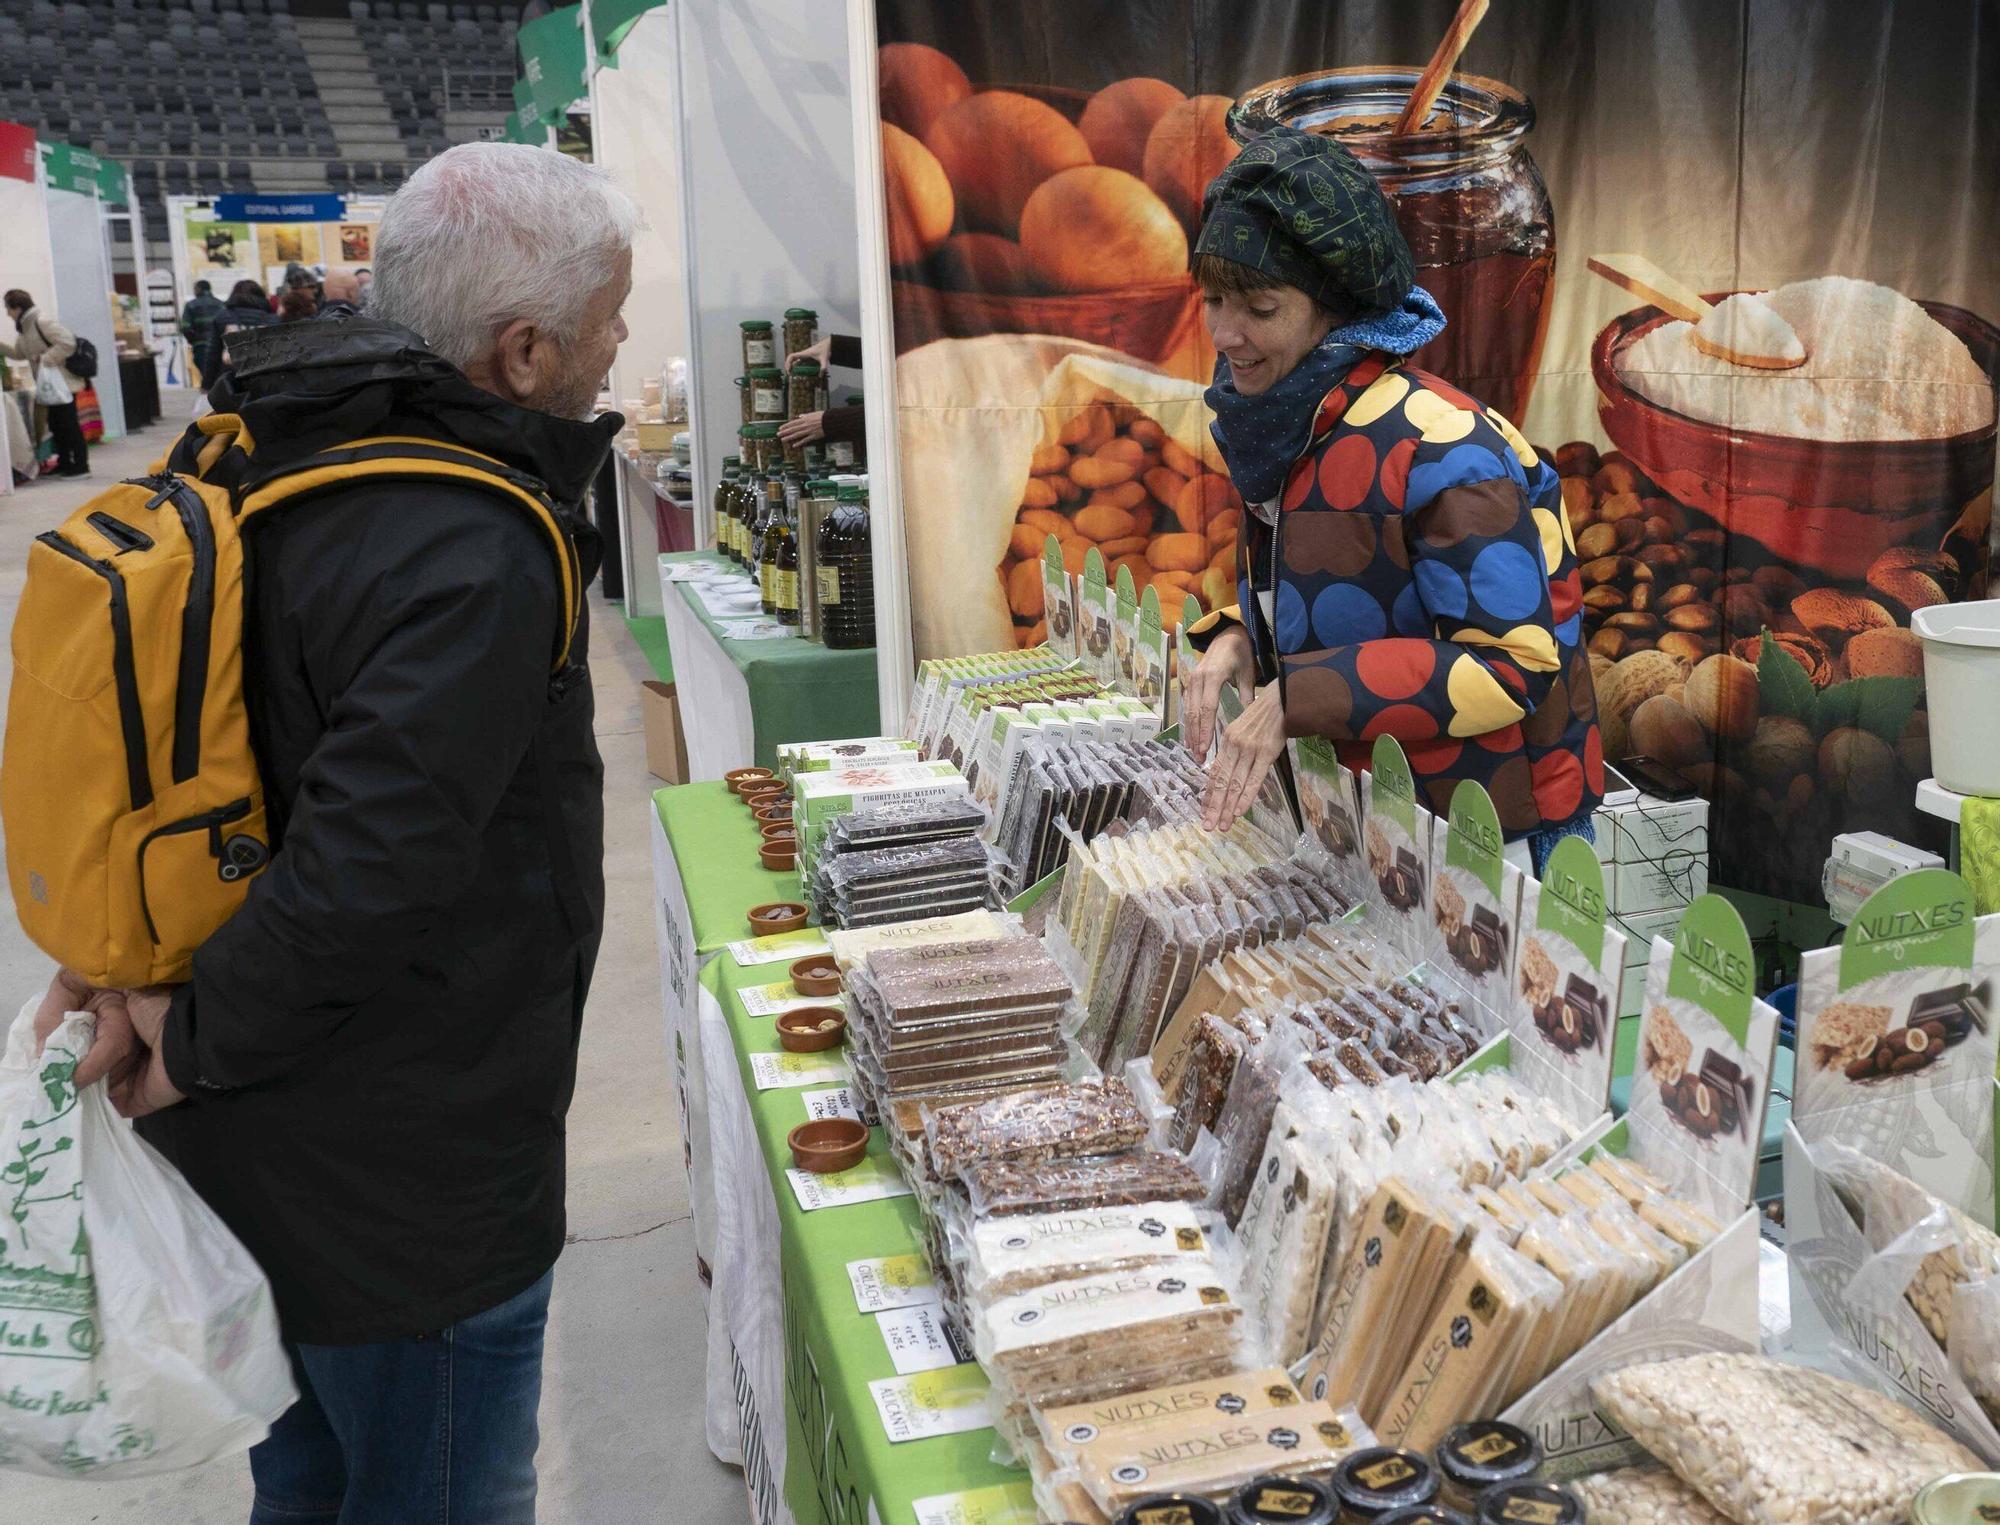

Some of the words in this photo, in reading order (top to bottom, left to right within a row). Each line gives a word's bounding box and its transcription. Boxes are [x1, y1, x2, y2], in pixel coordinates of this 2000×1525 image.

[1452, 808, 1498, 855] NUTXES
[872, 847, 944, 866] NUTXES
[1548, 866, 1601, 917] NUTXES
[878, 922, 953, 938] NUTXES
[1857, 900, 1966, 943] NUTXES
[911, 944, 994, 961] NUTXES
[1680, 926, 1748, 989] NUTXES
[924, 972, 1011, 990] NUTXES
[1037, 1162, 1140, 1187] NUTXES
[1034, 1214, 1134, 1240] NUTXES
[1042, 1276, 1150, 1310] NUTXES
[1845, 1310, 1956, 1422] NUTXES
[1386, 1335, 1448, 1438] NUTXES
[880, 1386, 911, 1438] ALICANTE
[1094, 1390, 1211, 1424] NUTXES
[1140, 1426, 1262, 1464] NUTXES
